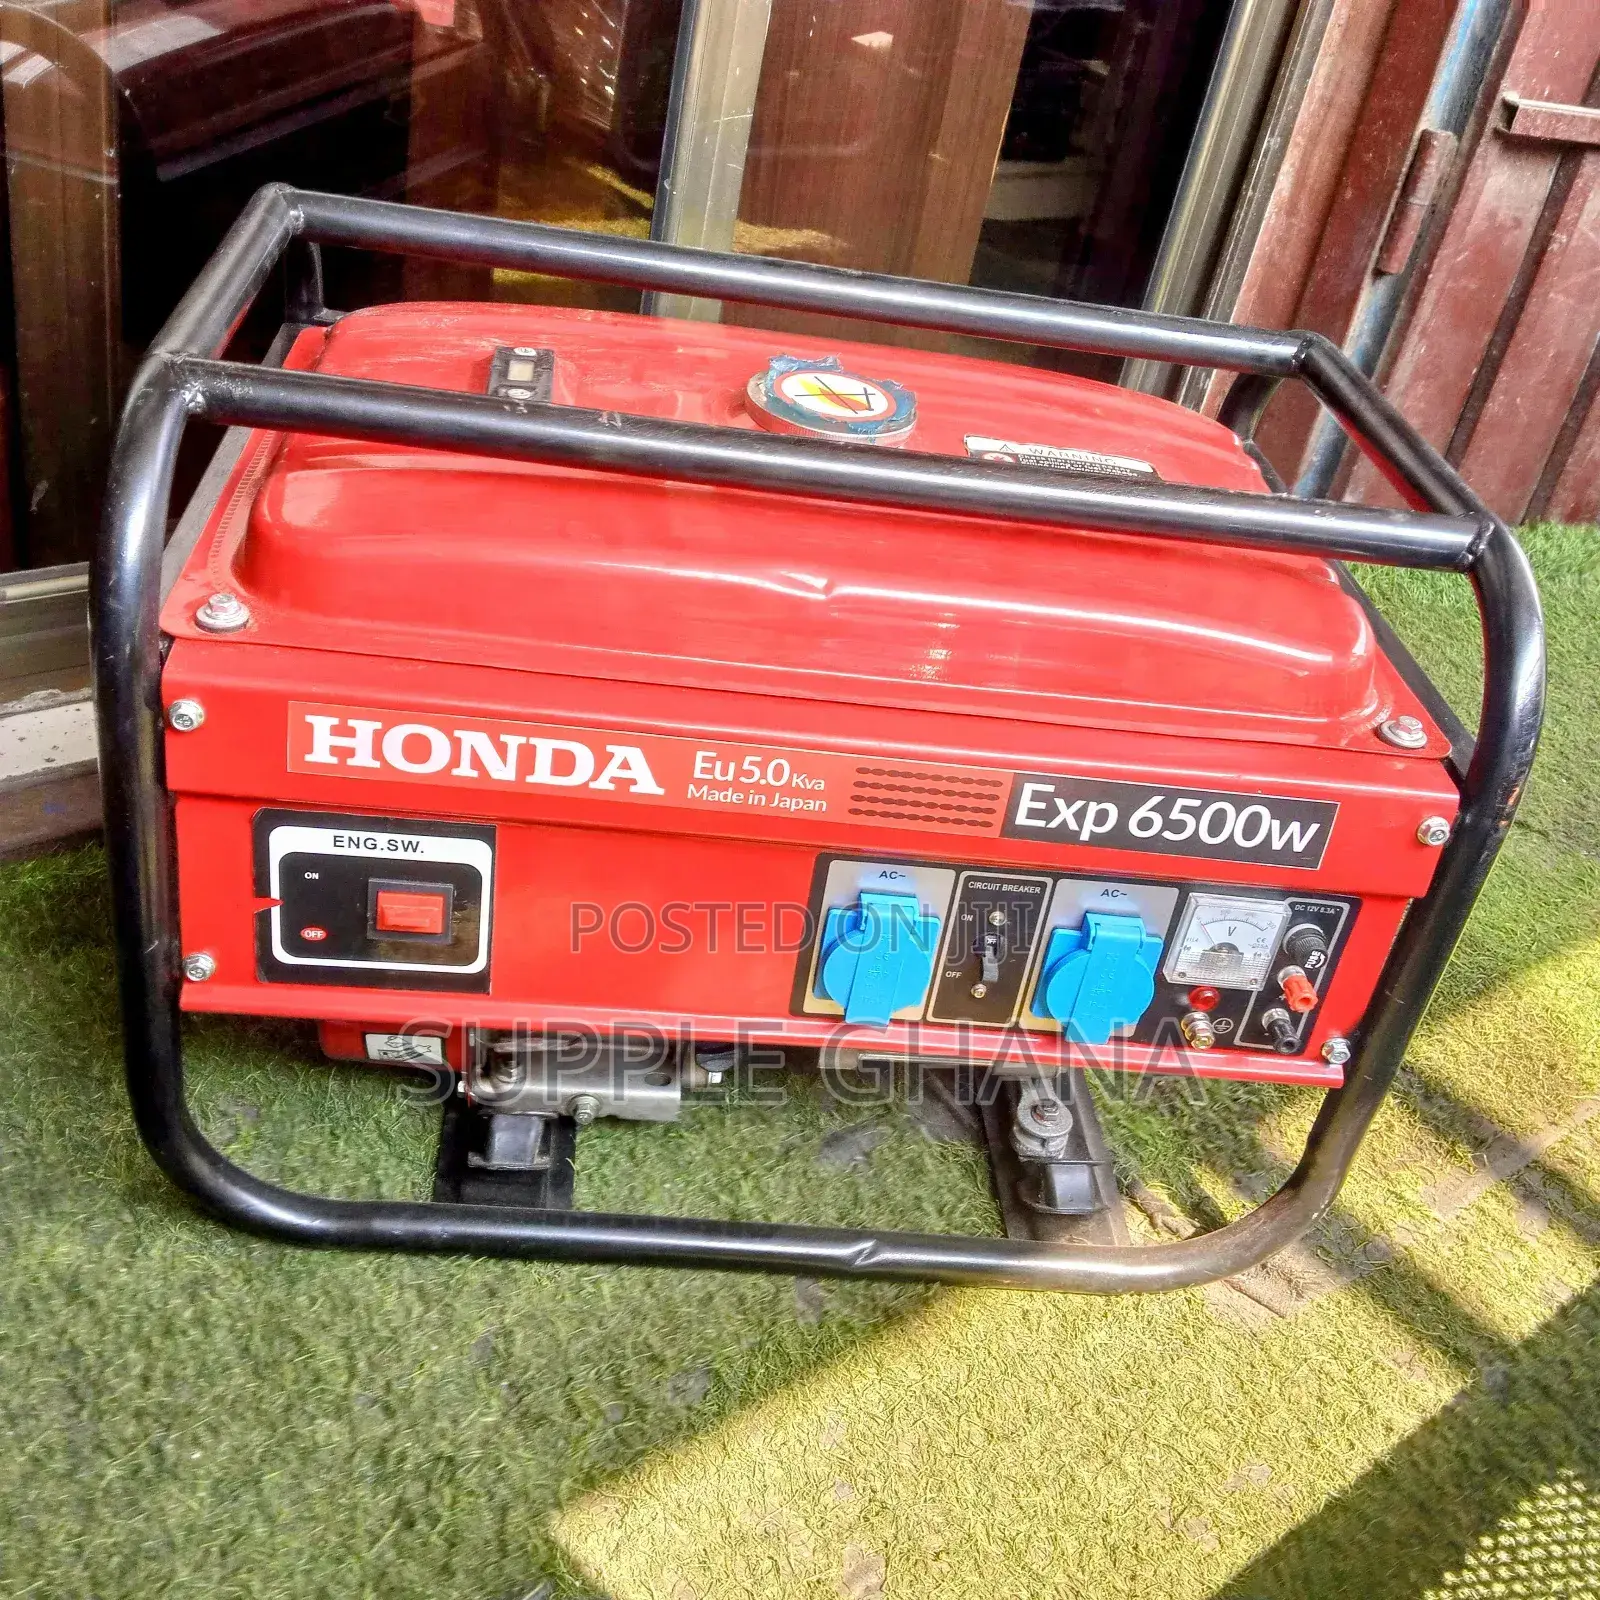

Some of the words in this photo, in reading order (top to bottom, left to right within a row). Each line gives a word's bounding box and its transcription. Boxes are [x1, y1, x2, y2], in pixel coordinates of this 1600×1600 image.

[304, 714, 665, 795] HONDA
[693, 750, 736, 782] Eu
[739, 755, 790, 787] 5.0
[791, 772, 825, 791] Kva
[687, 783, 744, 804] Made
[748, 789, 766, 807] in
[769, 792, 827, 812] Japan
[1014, 782, 1119, 842] Exp
[1128, 795, 1320, 853] 6500w
[333, 835, 425, 854] ENG.SW.
[304, 871, 319, 880] ON
[968, 881, 1001, 892] CIRCUIT
[1002, 883, 1041, 894] BREAKER
[961, 913, 974, 922] ON
[304, 930, 324, 939] OFF
[1228, 926, 1237, 937] V
[1304, 950, 1322, 969] FUSE
[945, 971, 963, 979] OFF
